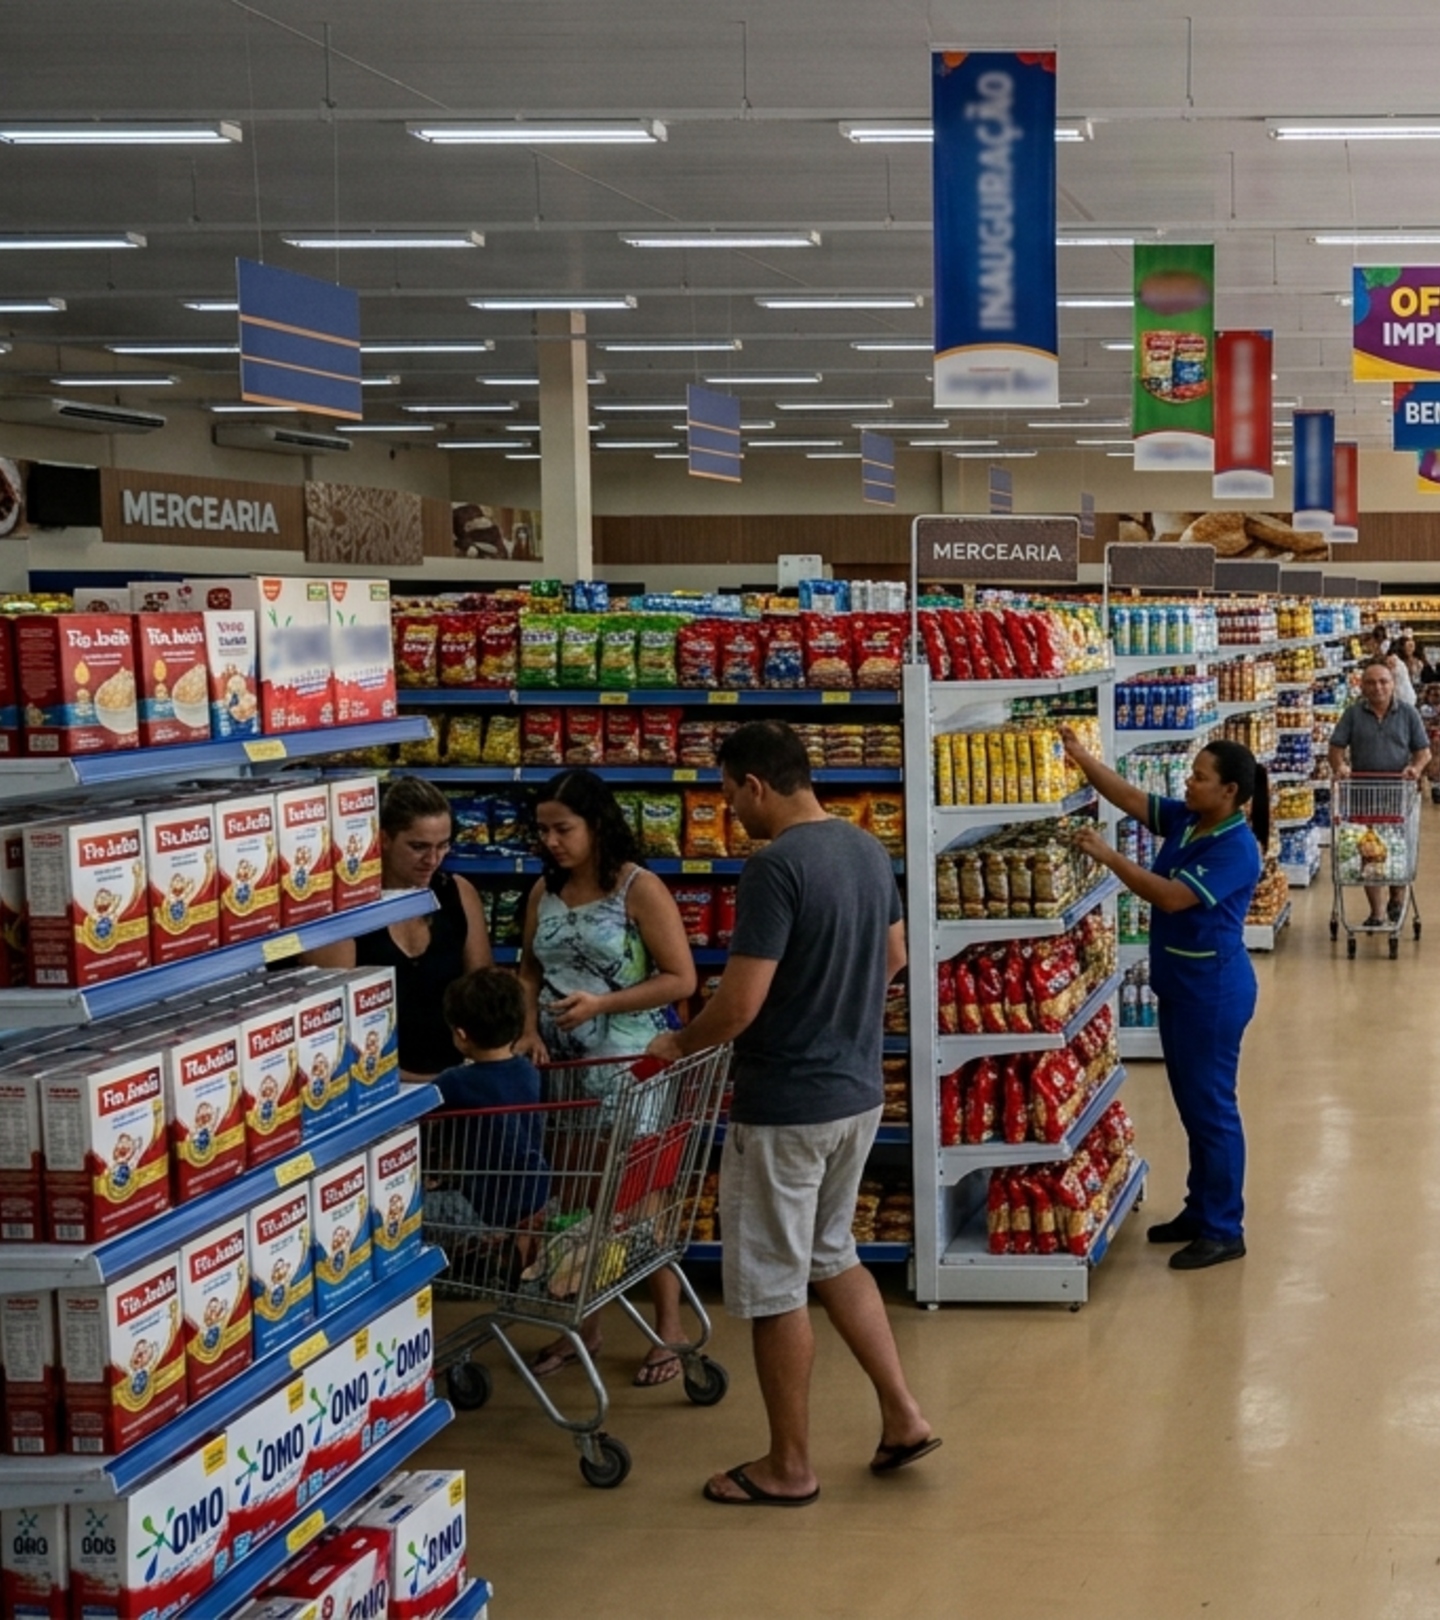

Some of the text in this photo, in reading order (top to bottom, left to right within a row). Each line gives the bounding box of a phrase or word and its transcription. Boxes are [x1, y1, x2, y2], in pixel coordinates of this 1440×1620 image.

[965, 70, 1024, 330] INAUGURAÇÃO
[122, 488, 280, 534] MERCEARIA
[933, 542, 1063, 562] MERCEARIA
[262, 1423, 304, 1482] OMO
[173, 1486, 224, 1555] OMO
